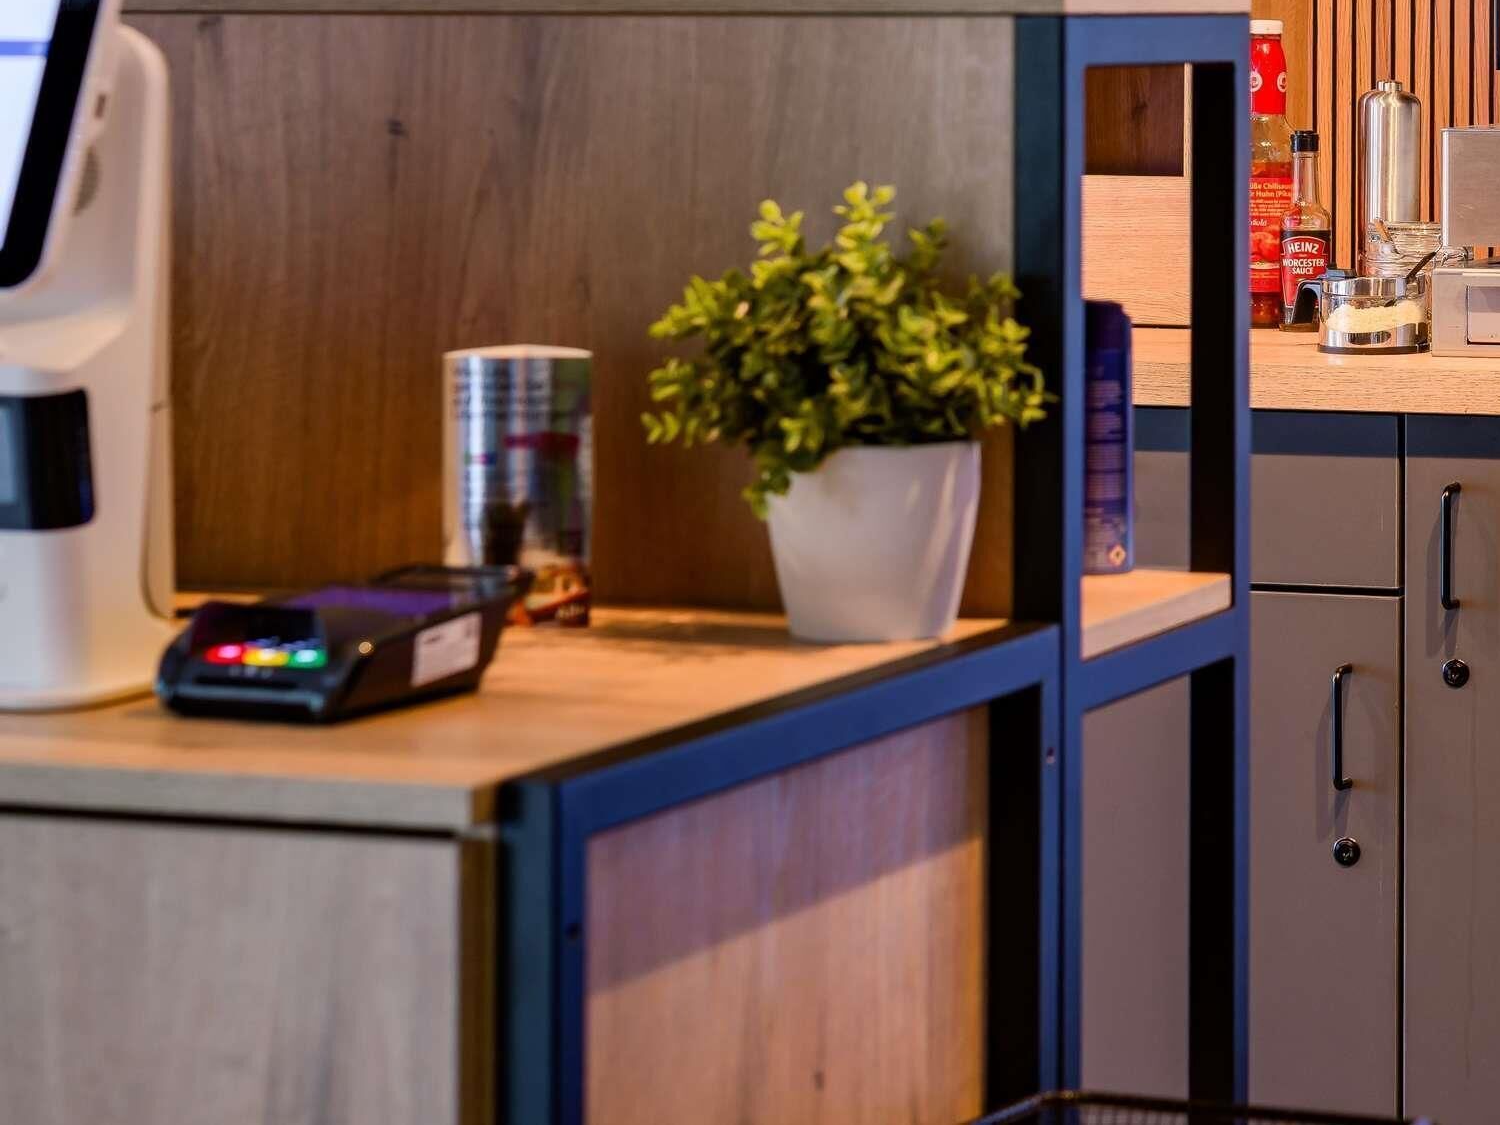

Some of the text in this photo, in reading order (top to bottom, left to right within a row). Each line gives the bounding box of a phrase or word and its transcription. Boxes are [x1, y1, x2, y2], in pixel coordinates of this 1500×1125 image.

[1287, 242, 1319, 254] HEINZ
[1283, 258, 1325, 267] WORCESTER
[1291, 267, 1314, 275] SAUCE
